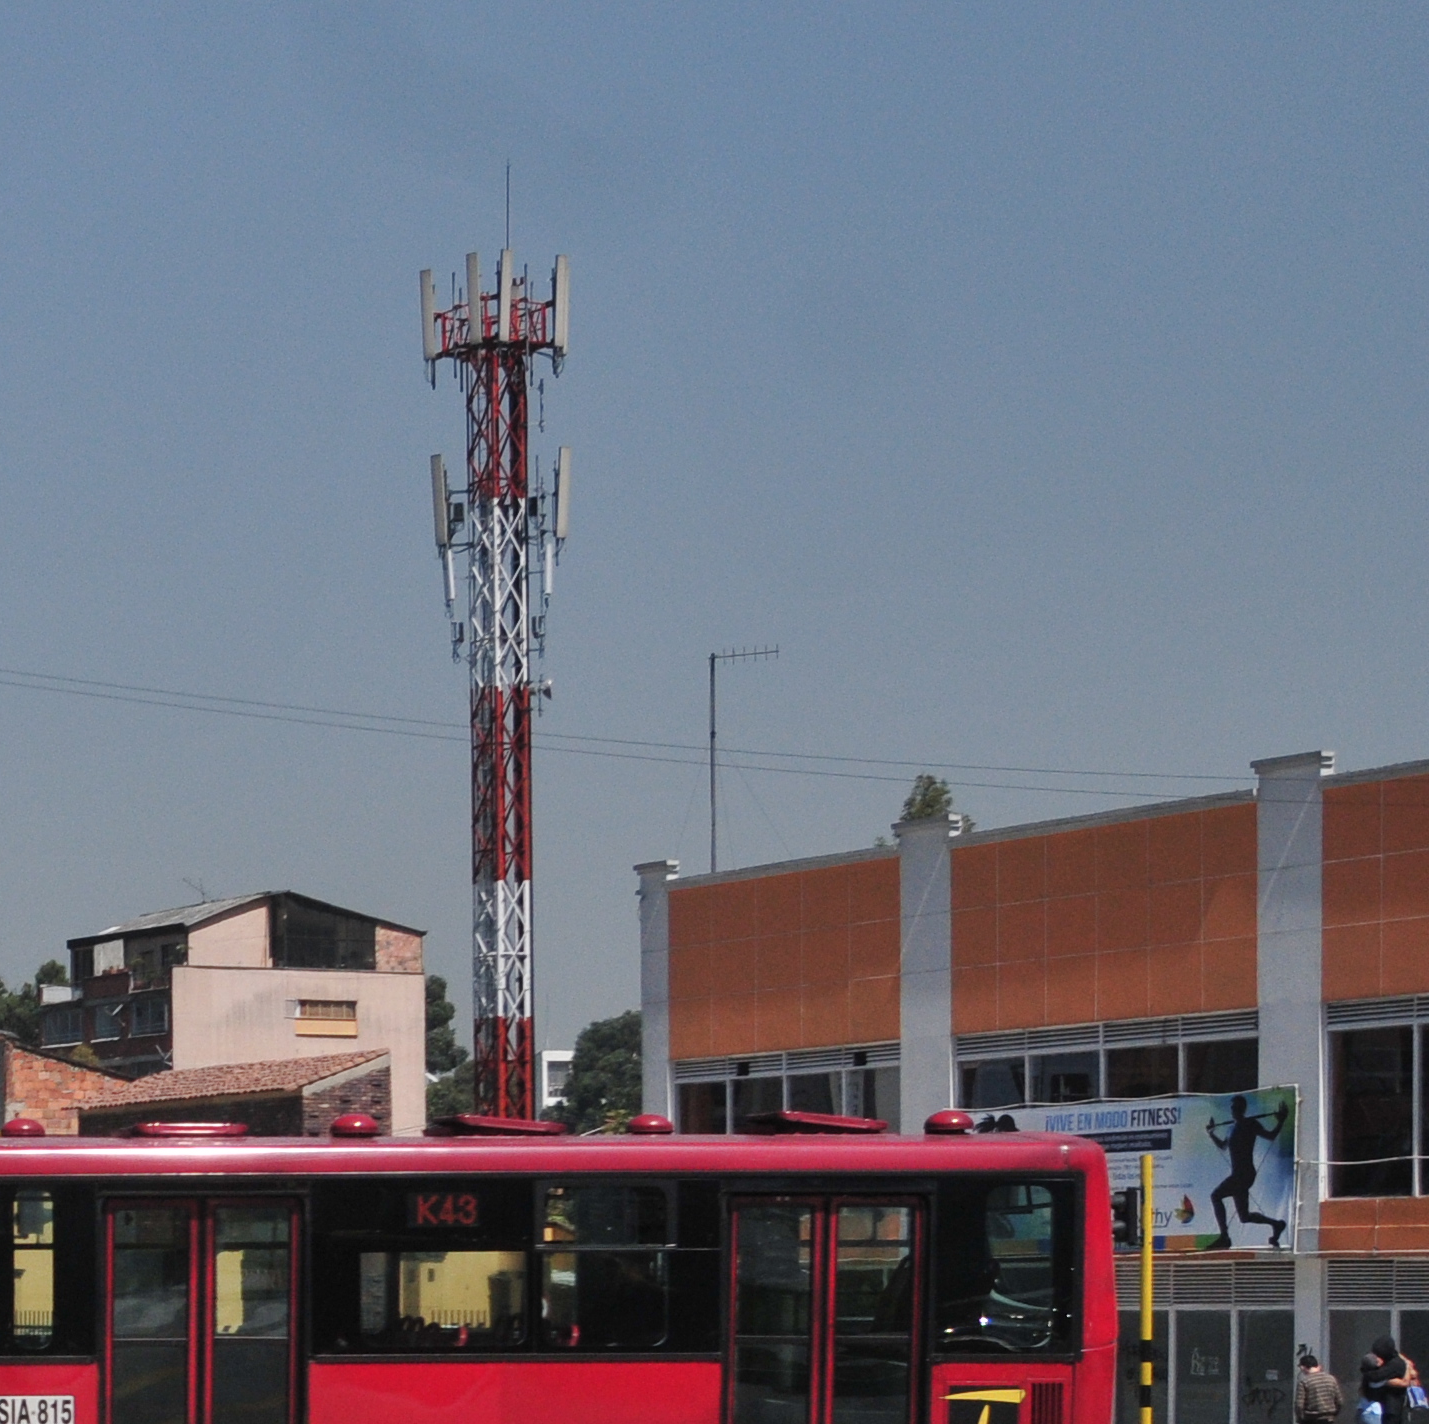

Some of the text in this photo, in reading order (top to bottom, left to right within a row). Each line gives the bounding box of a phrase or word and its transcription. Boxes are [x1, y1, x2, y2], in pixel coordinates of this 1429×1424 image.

[1077, 1112, 1092, 1131] EN
[1094, 1110, 1128, 1130] MODO
[1130, 1106, 1182, 1128] FITNESS!
[416, 1194, 478, 1225] K43
